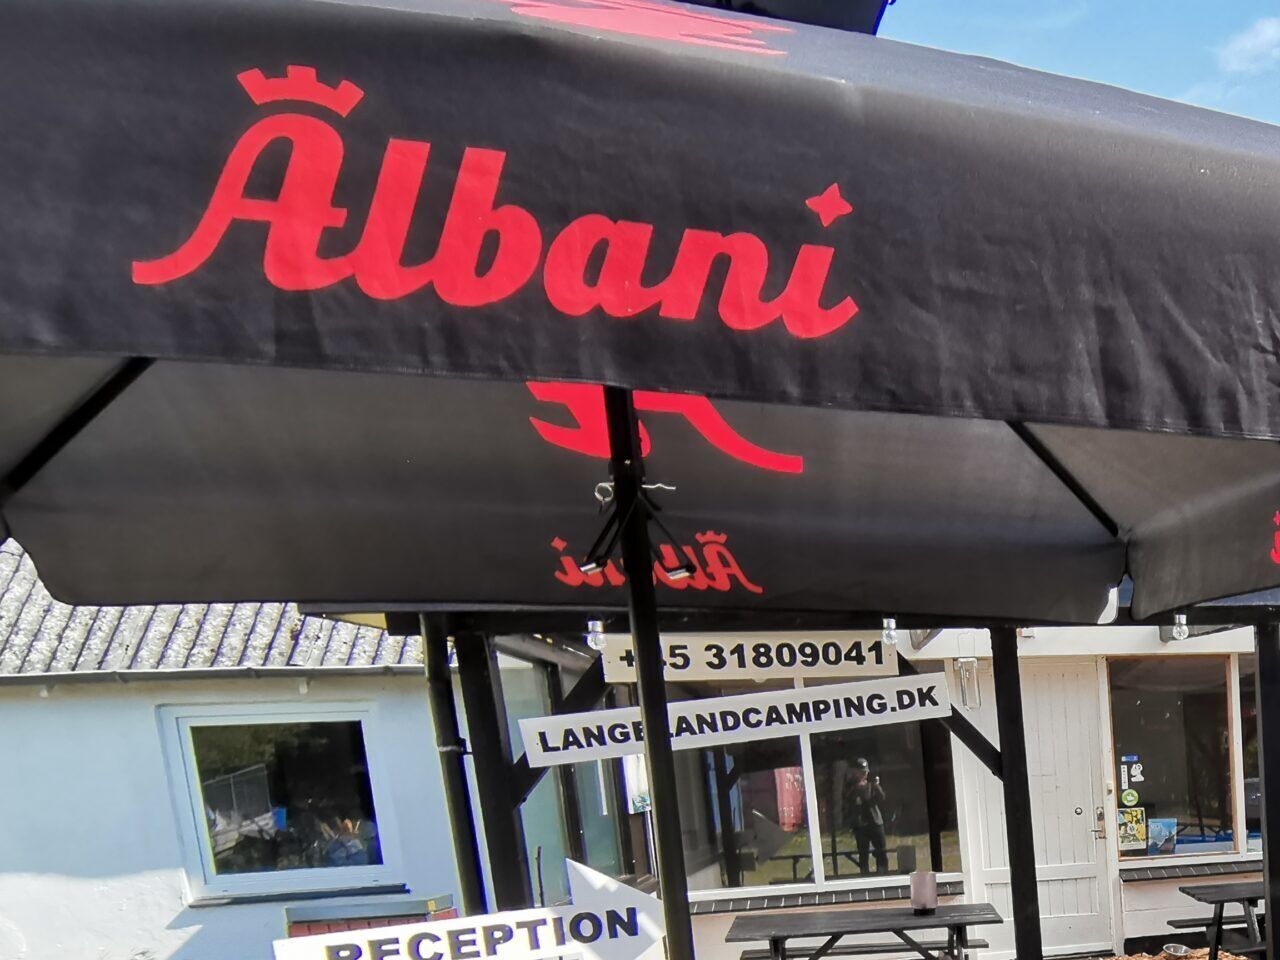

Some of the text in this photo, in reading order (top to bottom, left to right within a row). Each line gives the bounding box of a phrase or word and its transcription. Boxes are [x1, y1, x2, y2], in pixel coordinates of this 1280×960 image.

[131, 65, 859, 339] Albani
[619, 640, 884, 670] +5 31809041
[537, 685, 940, 753] LANGEANDCAMPING.DK
